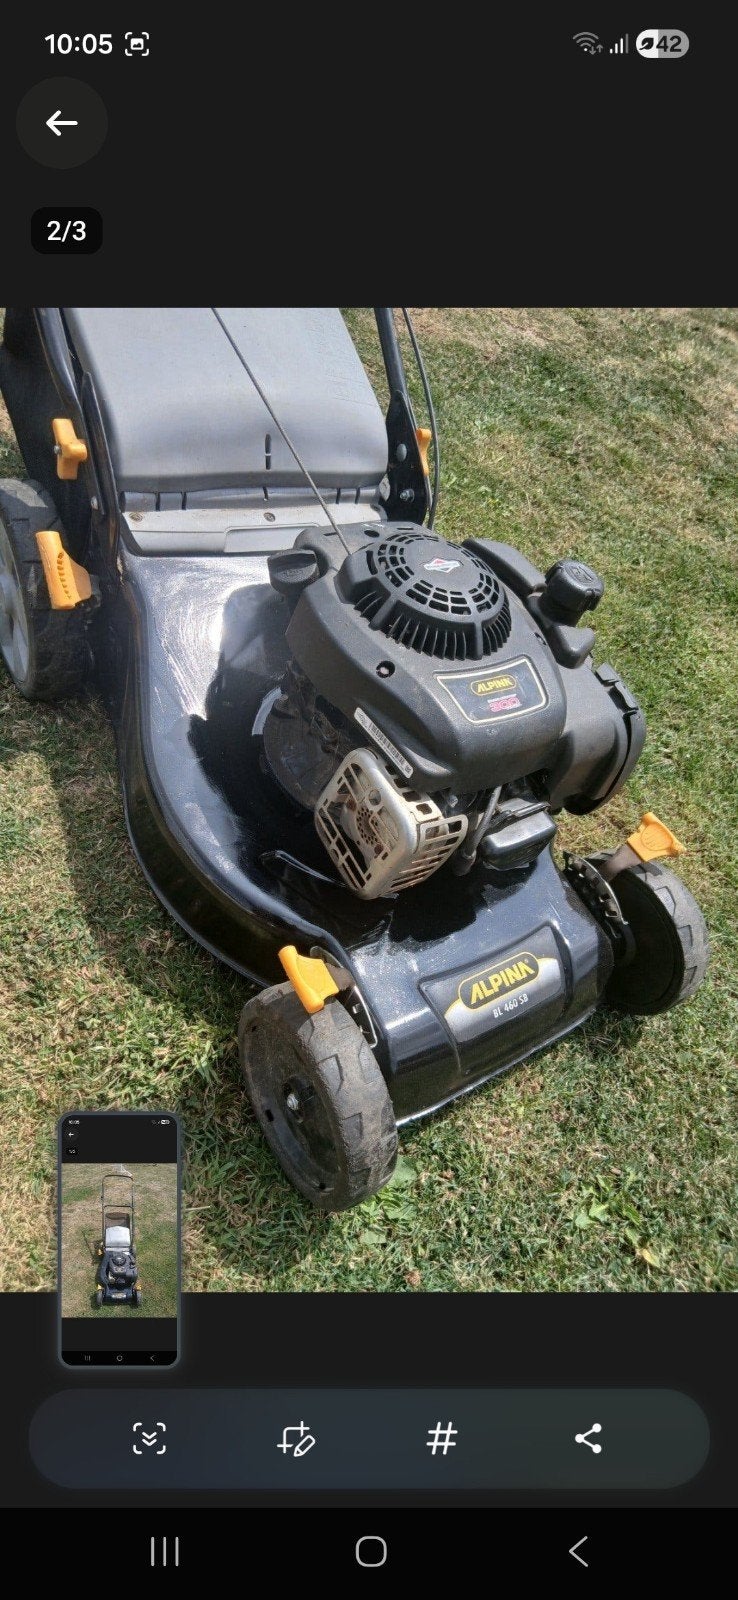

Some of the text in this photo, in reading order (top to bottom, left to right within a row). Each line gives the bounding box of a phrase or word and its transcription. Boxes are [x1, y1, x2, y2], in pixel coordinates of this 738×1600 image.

[45, 34, 112, 54] 10:05
[655, 35, 682, 53] 42
[47, 221, 87, 243] 2/3
[477, 677, 514, 693] ALPINA
[470, 960, 536, 1005] ALPINA
[492, 993, 529, 1019] BL 460 SB
